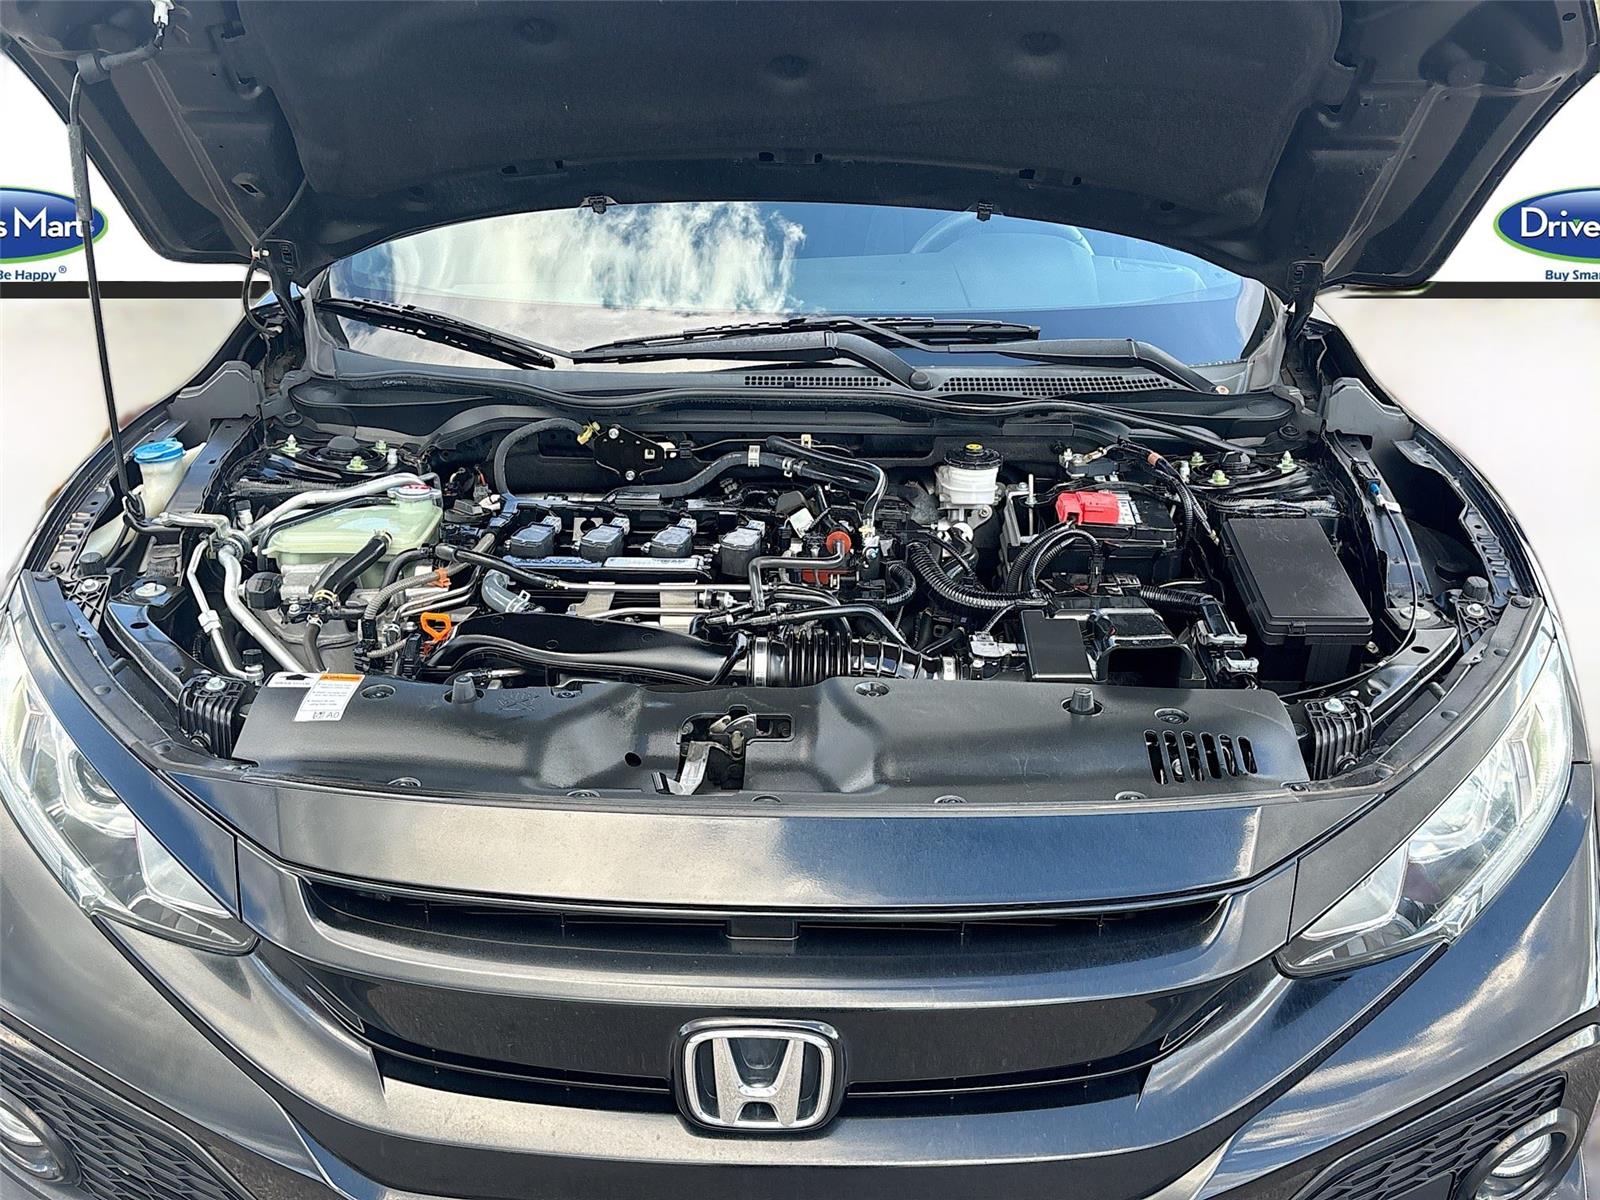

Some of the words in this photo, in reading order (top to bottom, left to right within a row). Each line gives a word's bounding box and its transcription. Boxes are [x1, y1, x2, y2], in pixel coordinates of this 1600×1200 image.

[14, 206, 84, 238] Mart
[1520, 207, 1600, 238] Drive
[15, 270, 57, 281] Happy
[1545, 269, 1570, 281] Buy
[1572, 269, 1600, 280] Sma
